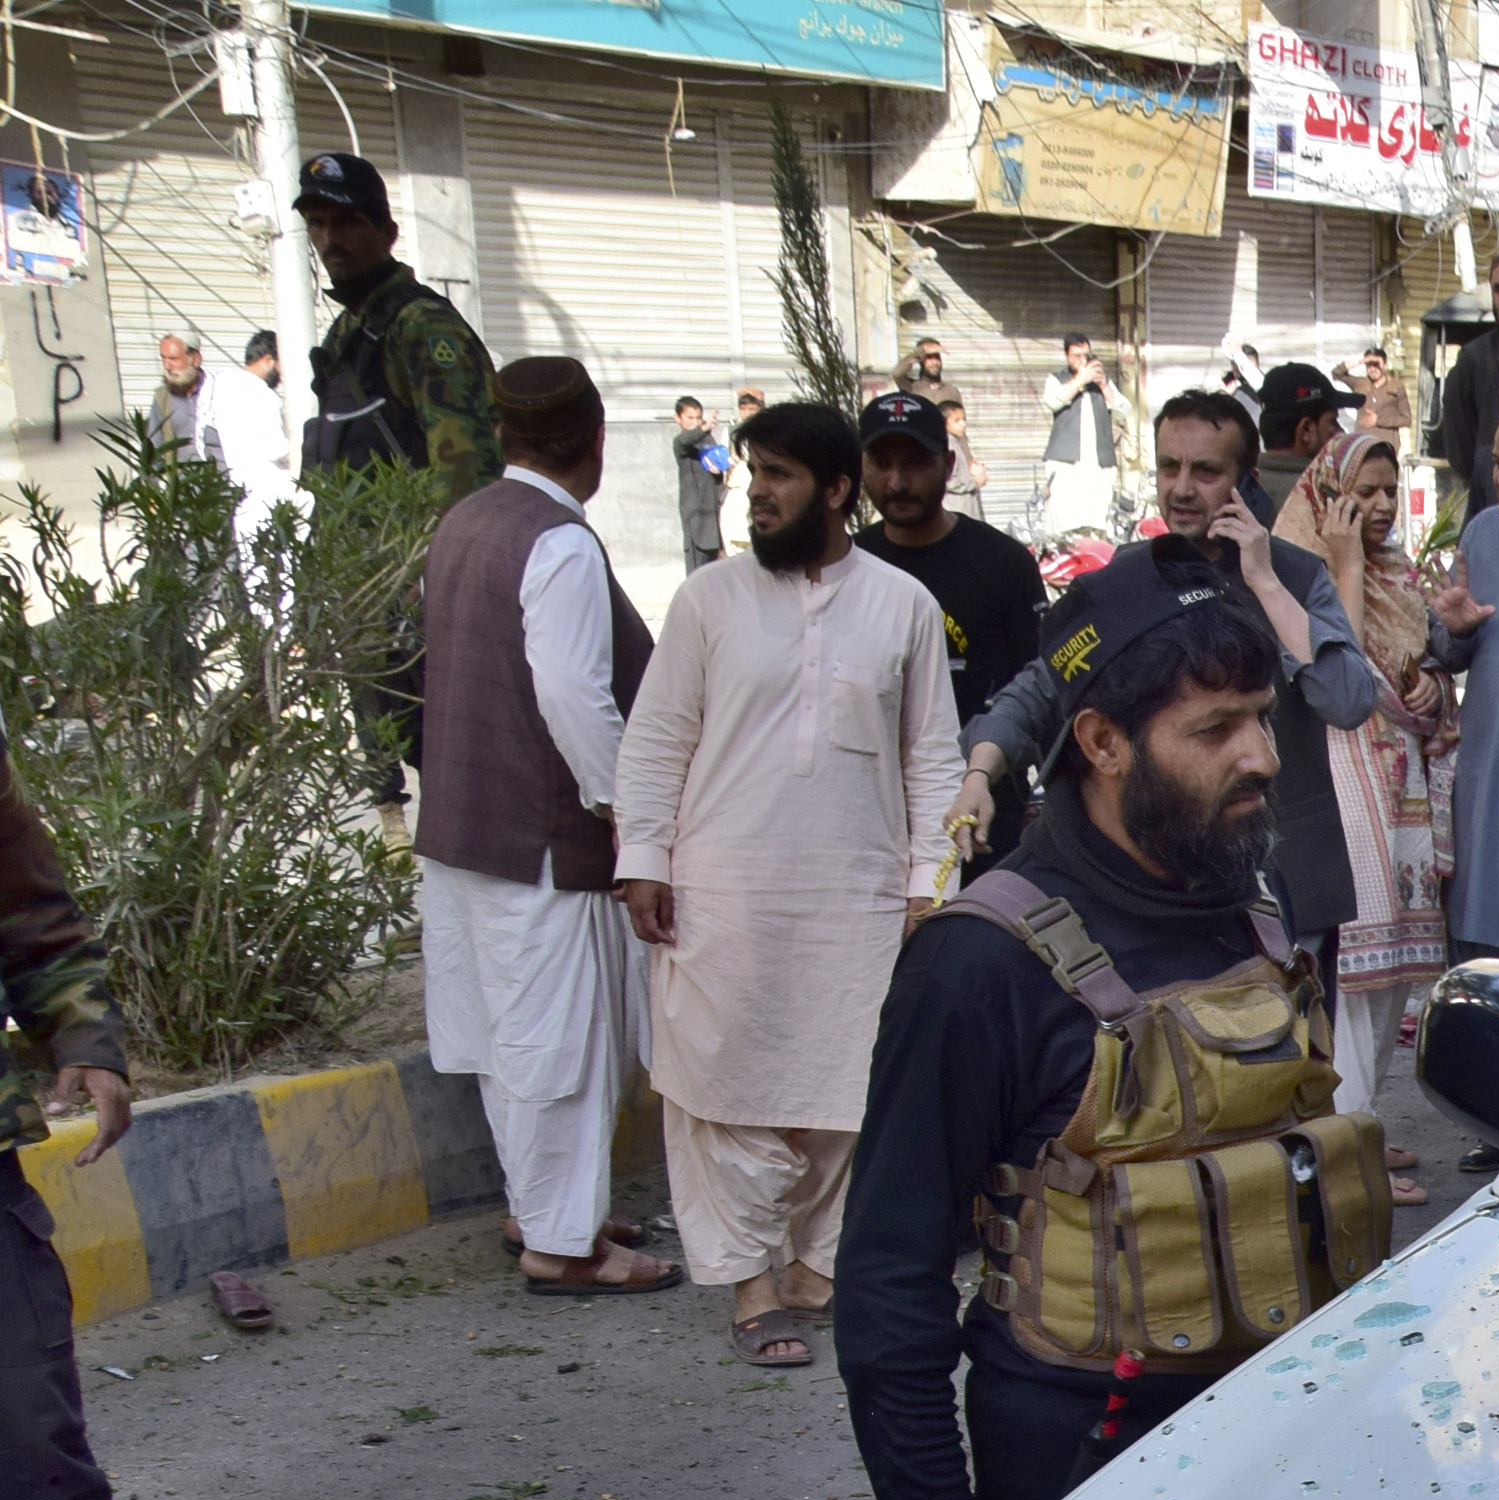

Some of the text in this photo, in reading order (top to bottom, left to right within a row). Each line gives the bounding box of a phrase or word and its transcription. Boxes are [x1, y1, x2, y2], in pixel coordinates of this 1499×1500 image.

[1258, 32, 1407, 87] GHAZI CLOTH
[1051, 623, 1098, 670] SECURITY
